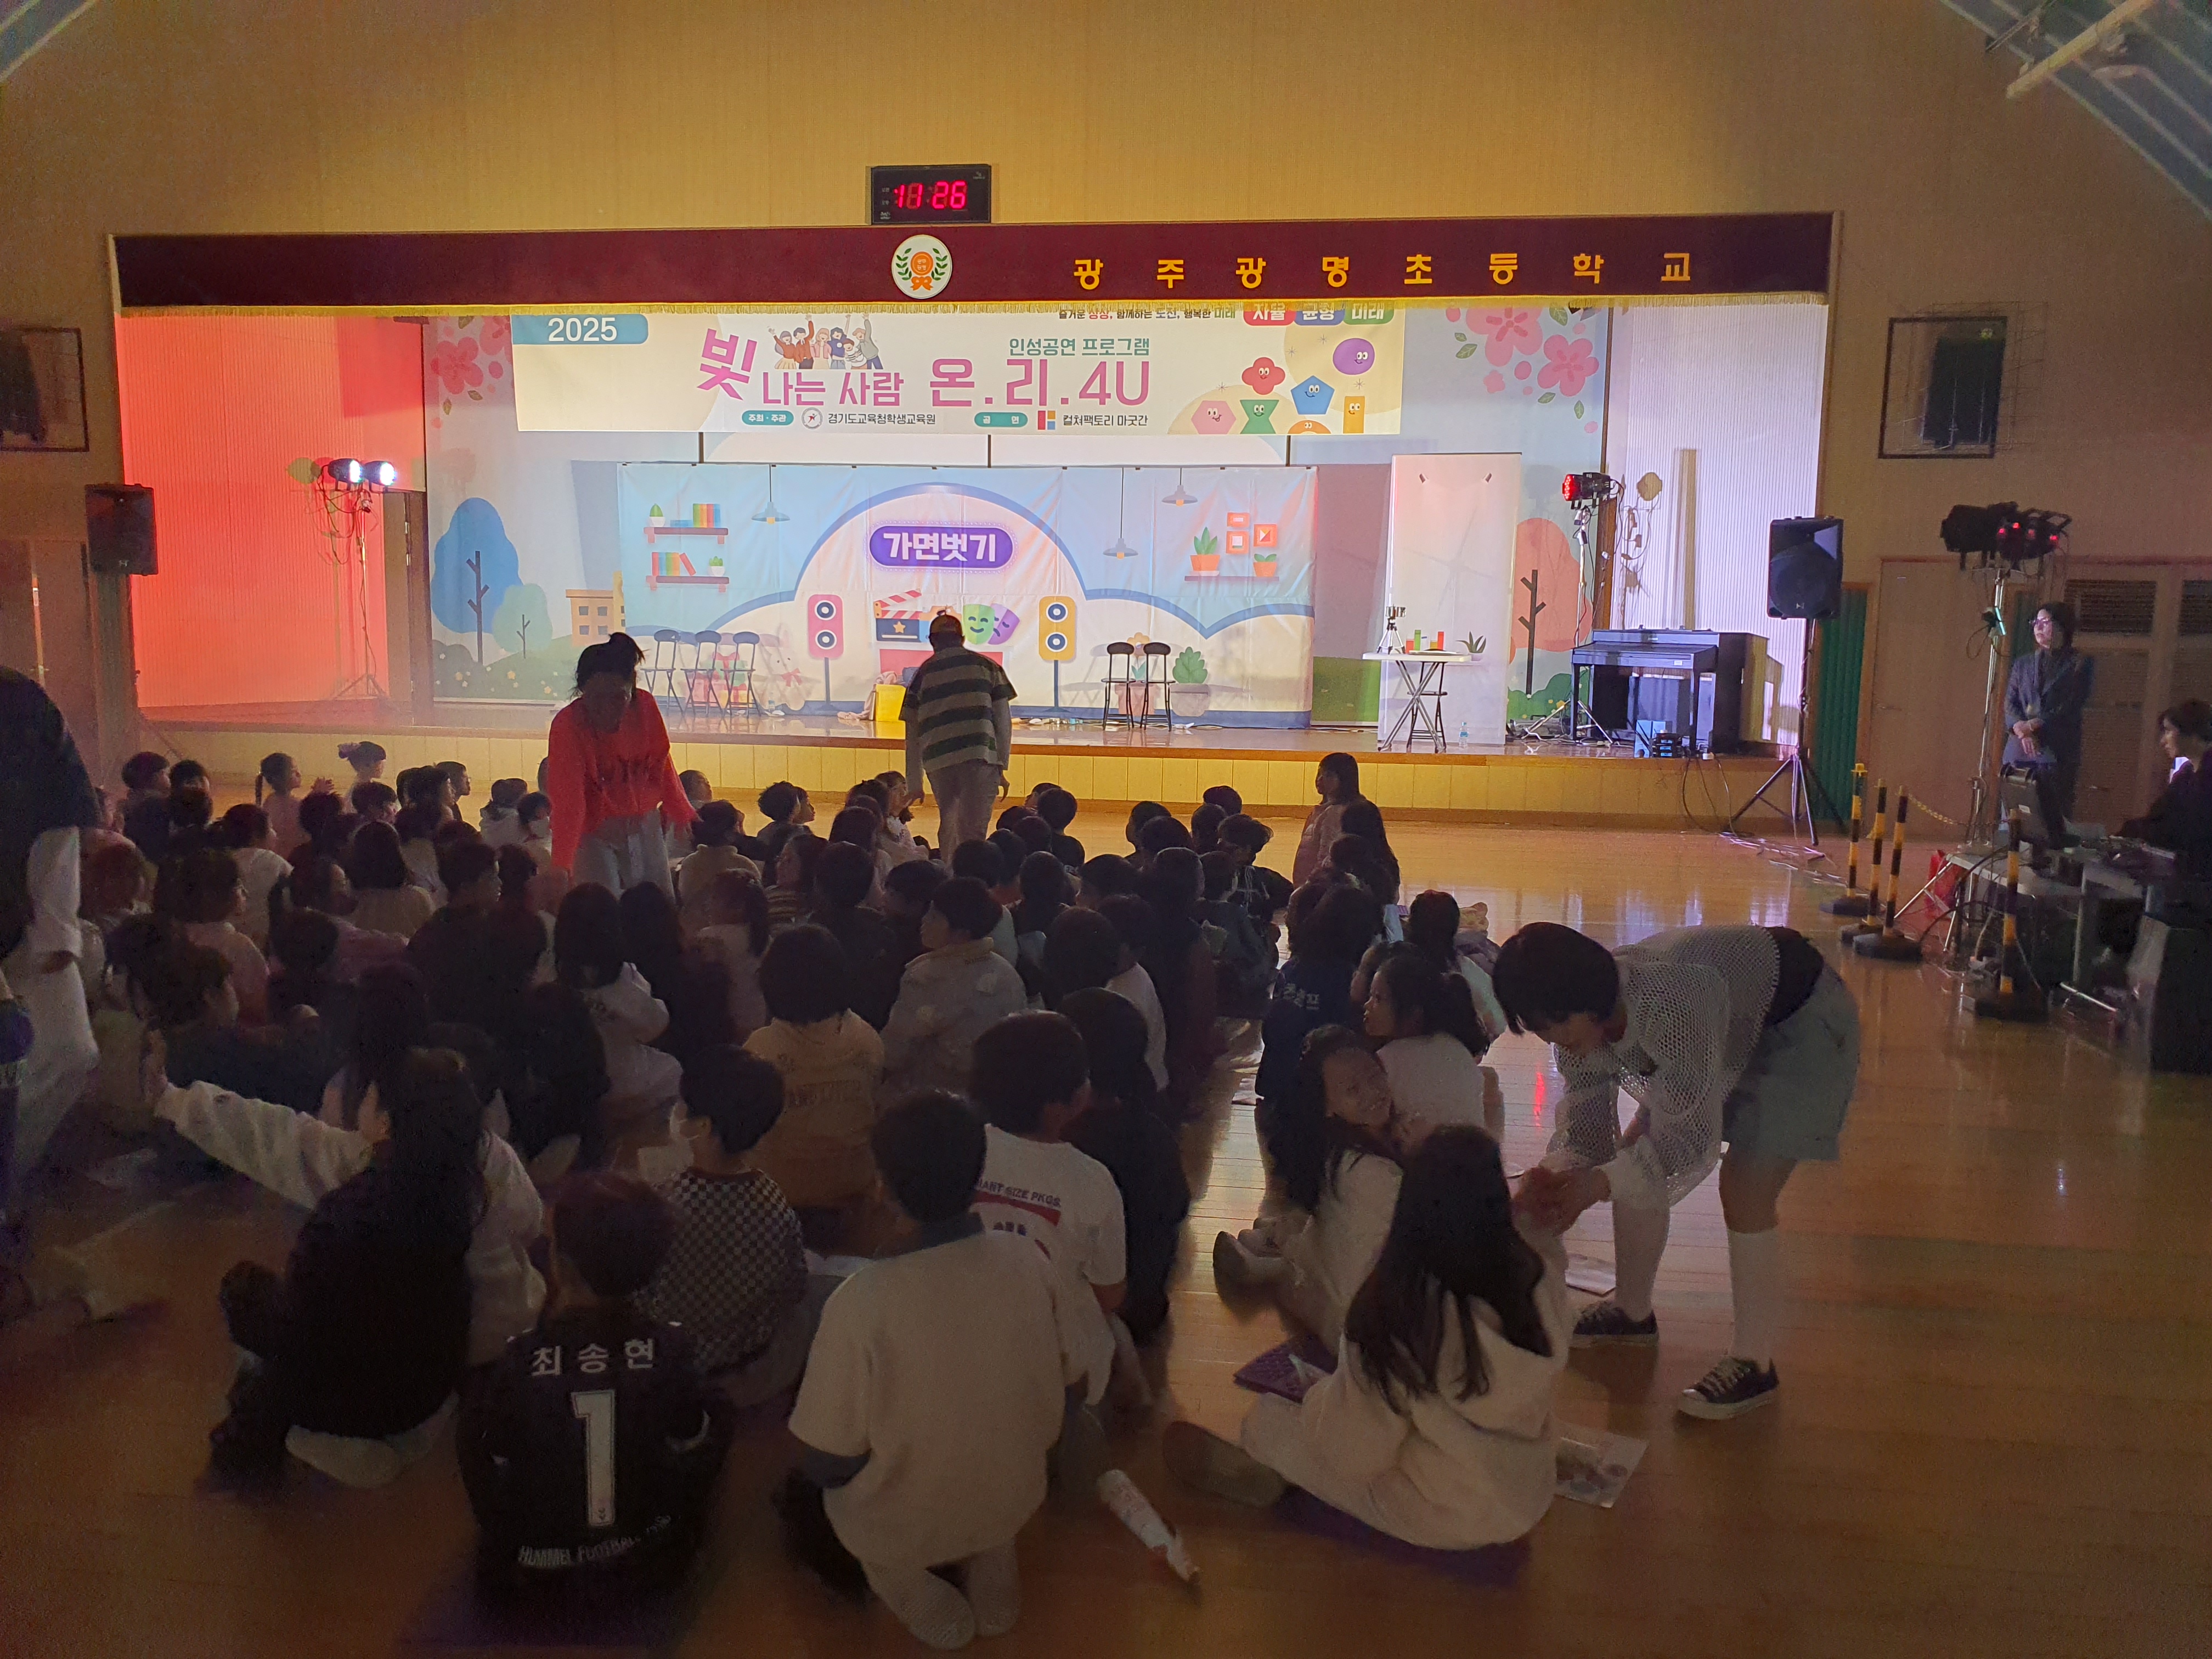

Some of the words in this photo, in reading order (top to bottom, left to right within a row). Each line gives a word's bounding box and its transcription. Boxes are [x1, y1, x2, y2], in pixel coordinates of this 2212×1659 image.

[1059, 309, 1086, 319] 즐거운
[548, 317, 617, 342] 2025
[1009, 338, 1075, 356] 인성공연
[1081, 338, 1149, 356] 프로그램
[696, 328, 757, 400] 빛
[763, 372, 826, 406] 나는
[839, 372, 905, 407] 사람
[828, 413, 935, 425] 경기도교육청학생교육원
[1063, 415, 1114, 426] 컬쳐팩토리
[1117, 415, 1148, 426] 마굿간
[883, 532, 996, 562] 가면벗기
[531, 1338, 655, 1376] 최송현
[571, 1389, 616, 1528] 1
